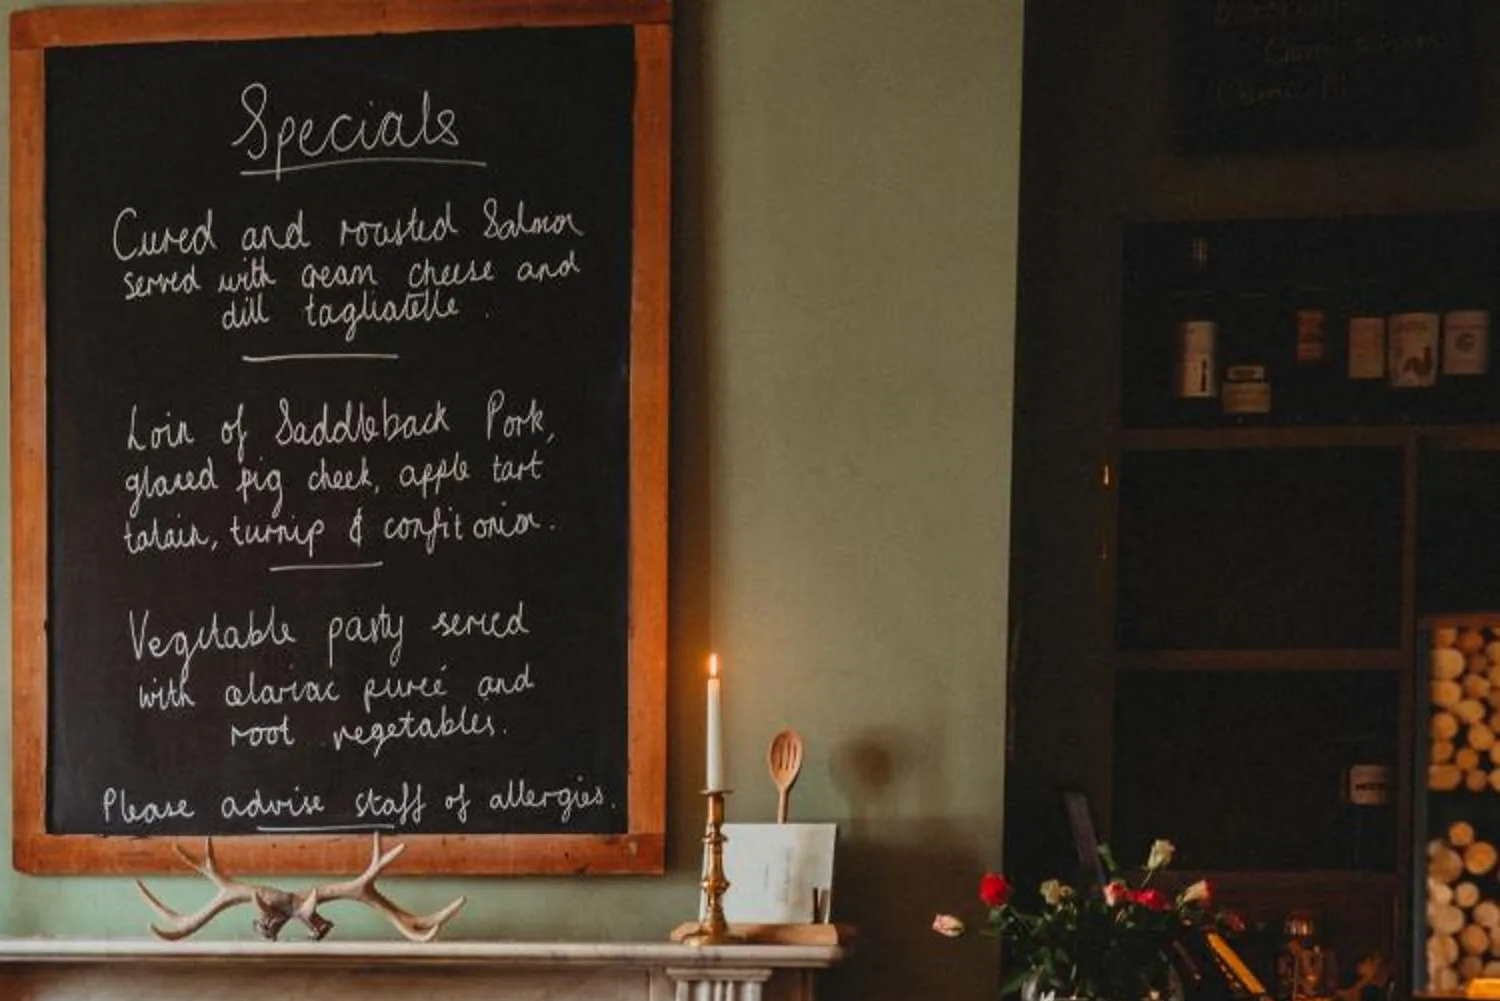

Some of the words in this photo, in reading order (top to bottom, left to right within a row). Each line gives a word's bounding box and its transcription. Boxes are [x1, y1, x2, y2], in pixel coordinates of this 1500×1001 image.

[232, 83, 459, 181] Specials
[113, 207, 217, 261] Cured
[241, 208, 311, 252] and
[340, 200, 459, 248] roasted
[124, 264, 202, 301] served
[217, 255, 277, 294] with
[409, 257, 494, 289] cheese
[517, 249, 581, 283] and
[221, 292, 270, 331] dill
[126, 403, 196, 452] Loin
[220, 401, 248, 463] of
[275, 396, 450, 447] Saddleback
[486, 388, 556, 444] Pork,
[235, 456, 282, 519] pig
[307, 456, 380, 494] cheek,
[399, 451, 471, 500] apple
[492, 449, 544, 483] tart
[230, 514, 326, 559] turnip
[349, 506, 363, 549] &
[383, 505, 464, 556] confit
[128, 605, 298, 677] Vegetable
[138, 677, 196, 711] with
[477, 662, 535, 698] and
[230, 714, 295, 748] root
[103, 787, 195, 824] Please
[220, 785, 326, 817] advise
[355, 781, 426, 825] staff
[444, 783, 471, 823] of
